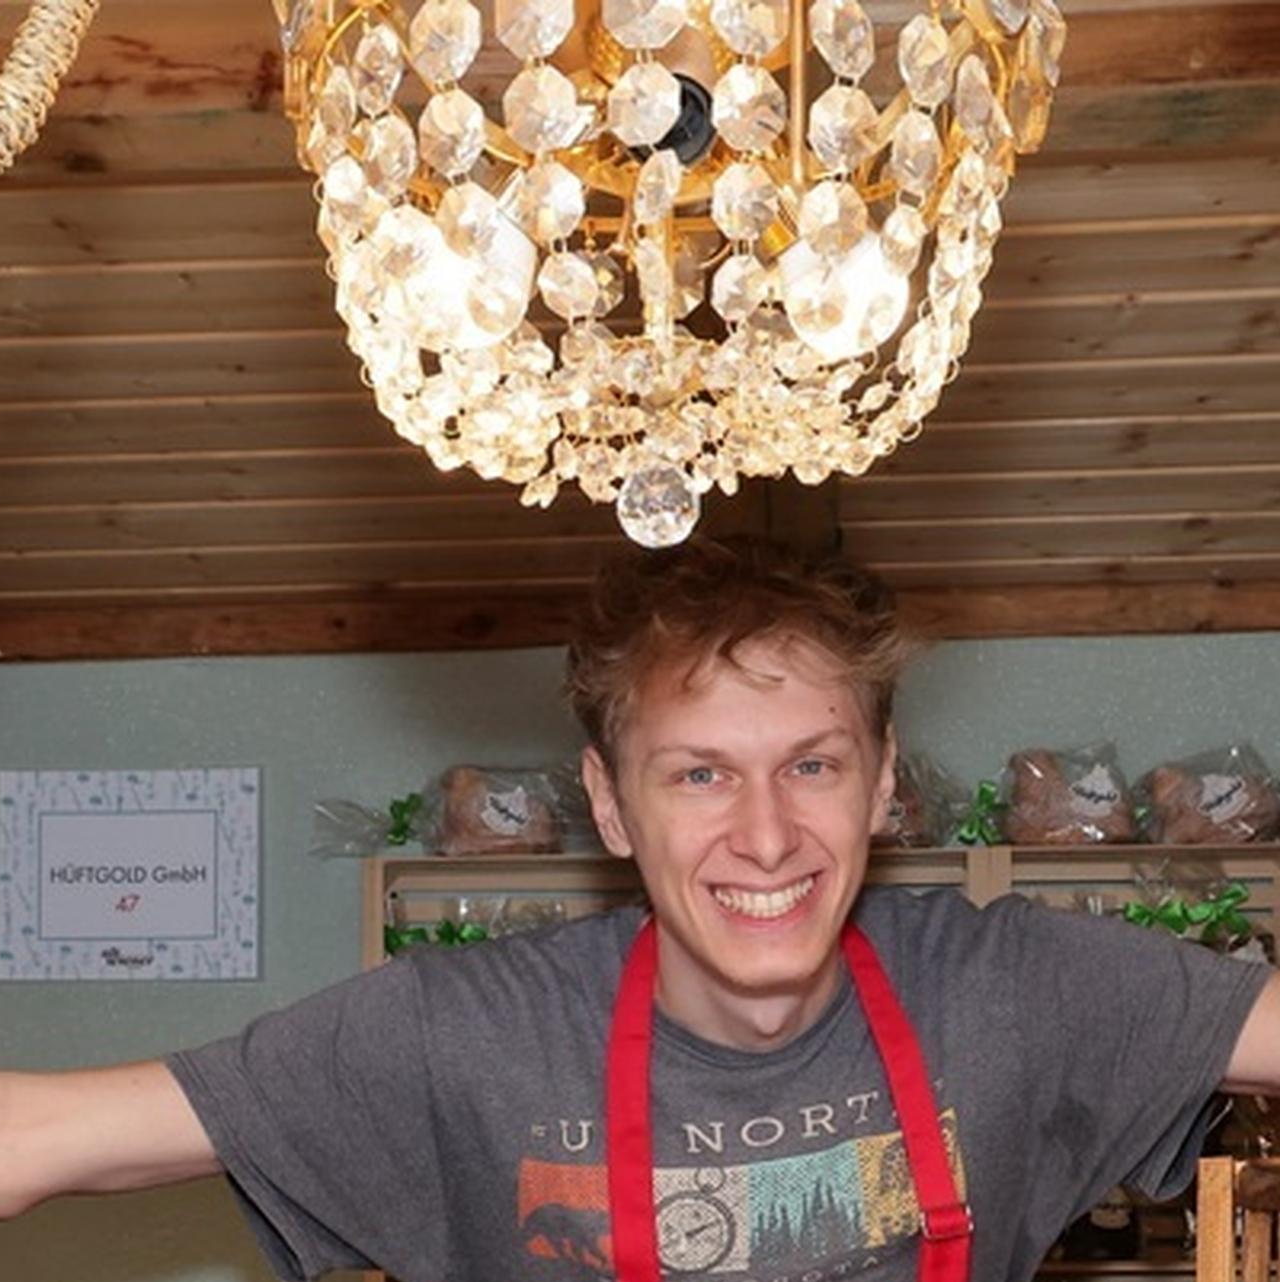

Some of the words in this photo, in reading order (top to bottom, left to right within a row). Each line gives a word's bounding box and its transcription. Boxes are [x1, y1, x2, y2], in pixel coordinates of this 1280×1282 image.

[50, 864, 147, 885] HÜFTGOLD
[152, 864, 208, 884] GmbH
[682, 1091, 880, 1154] NORT
